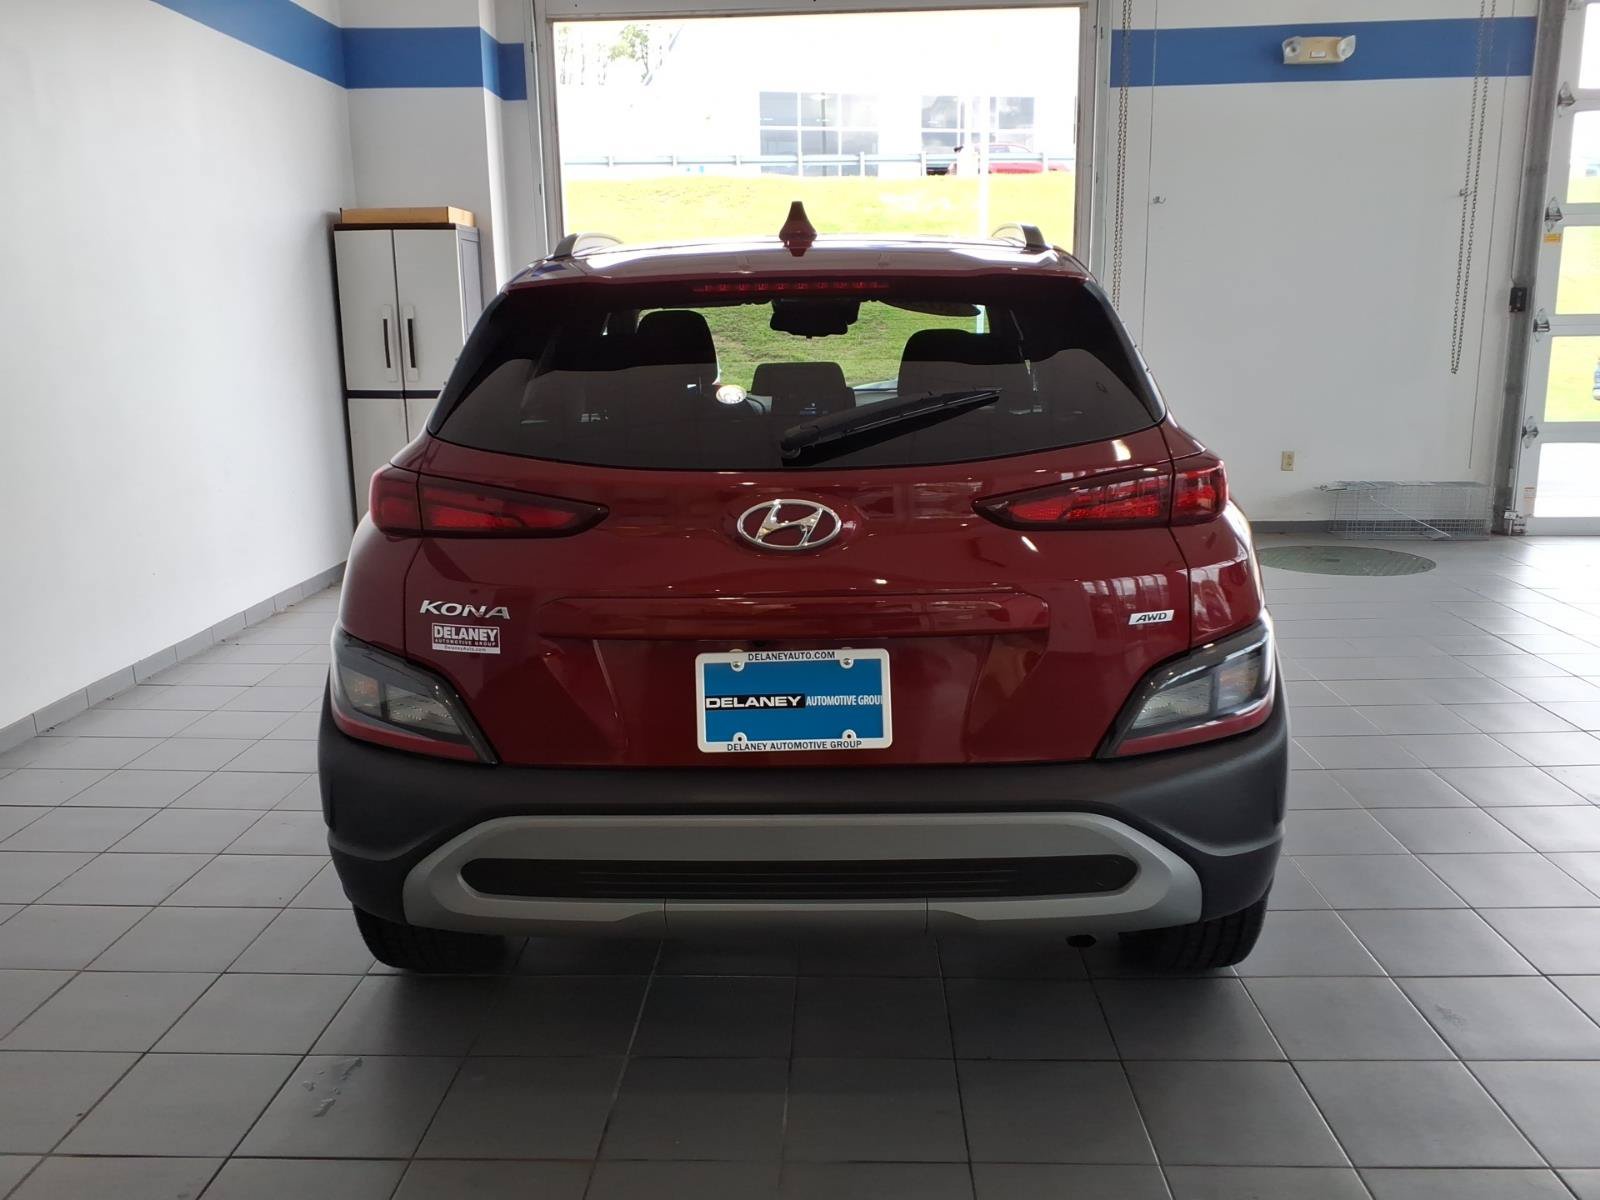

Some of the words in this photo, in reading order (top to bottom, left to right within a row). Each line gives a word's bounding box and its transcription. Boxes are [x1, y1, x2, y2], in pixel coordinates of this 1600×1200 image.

[420, 600, 510, 619] KONA
[1136, 612, 1167, 622] AWD
[434, 626, 498, 641] DELANEY
[748, 651, 836, 661] DELANEYAUTO.COM
[706, 696, 801, 708] DELANEY
[806, 695, 857, 707] AUTOMOTIVE
[727, 742, 769, 752] DELANEY
[770, 741, 828, 751] AUTOMOTIVE
[830, 740, 863, 749] GROUP
